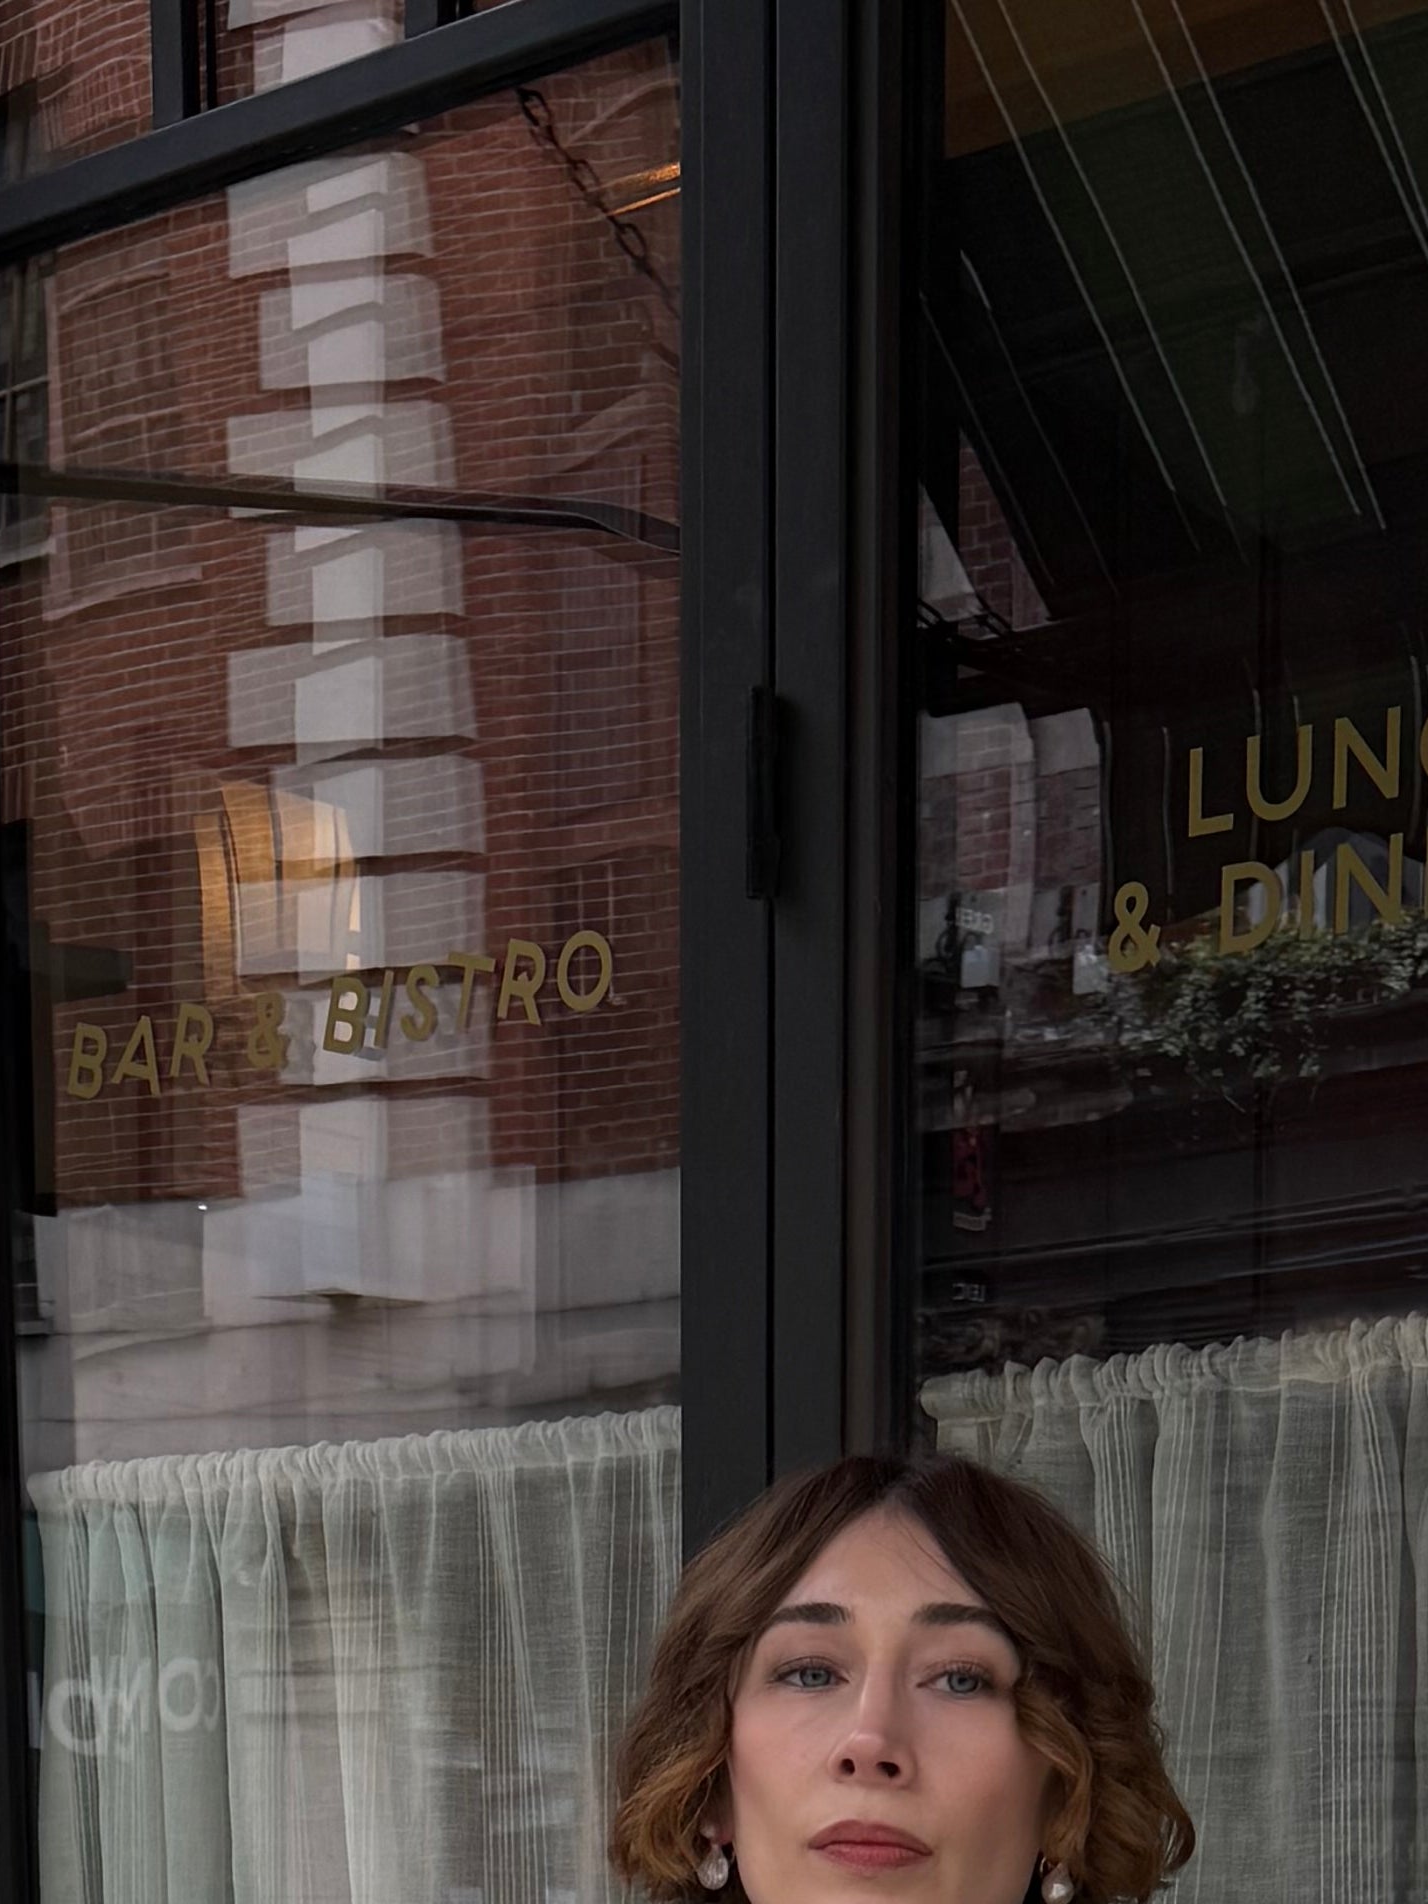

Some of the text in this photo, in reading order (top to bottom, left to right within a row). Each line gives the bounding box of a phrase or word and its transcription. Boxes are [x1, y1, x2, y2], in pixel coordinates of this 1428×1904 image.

[1108, 881, 1162, 974] &
[67, 930, 613, 1099] BAR & BISTRO
